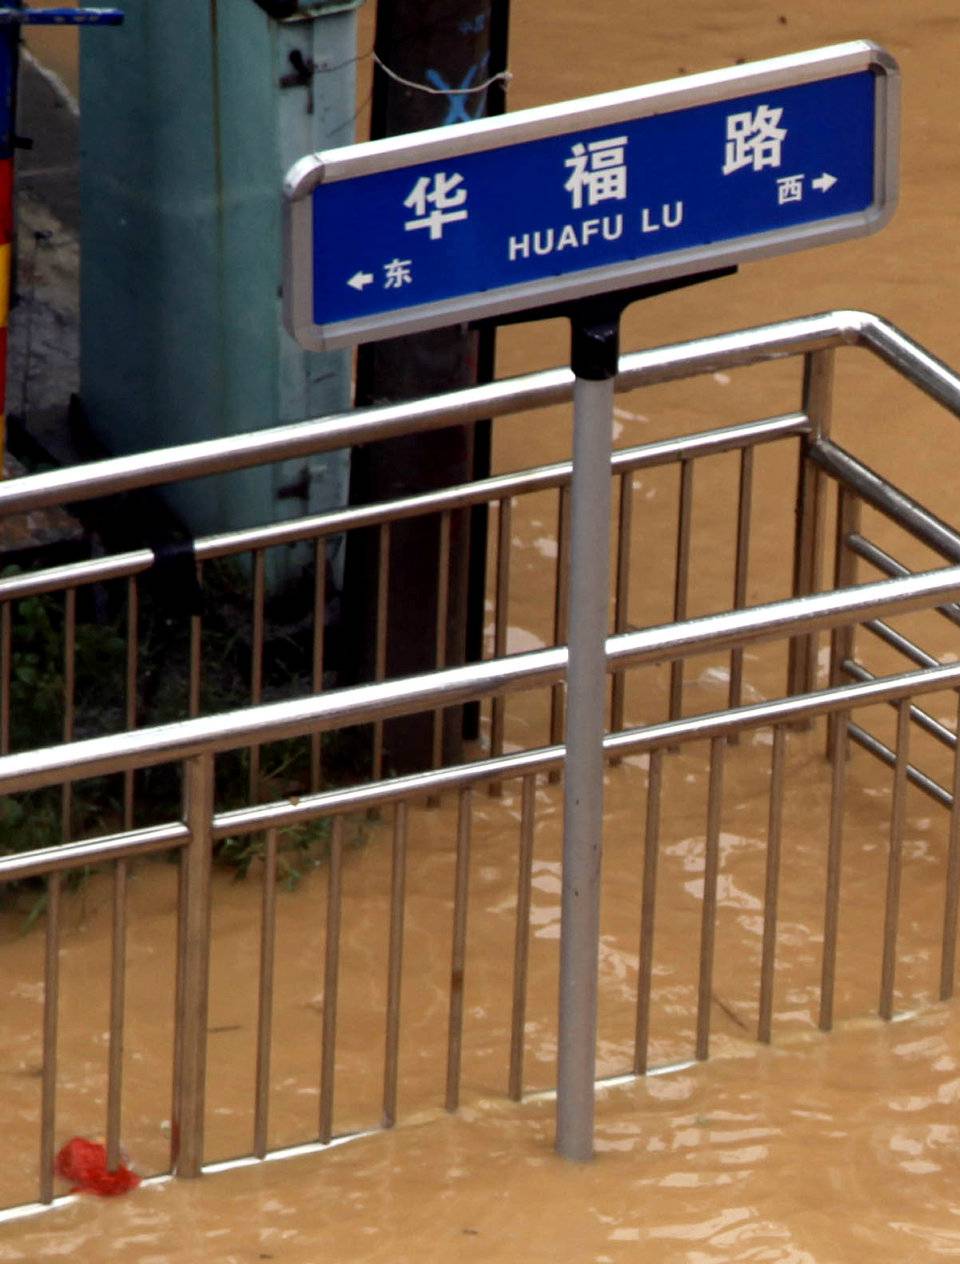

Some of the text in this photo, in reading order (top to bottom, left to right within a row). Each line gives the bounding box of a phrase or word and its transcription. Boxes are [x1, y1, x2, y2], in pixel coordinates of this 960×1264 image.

[404, 105, 787, 240] 华福路
[776, 174, 805, 205] 西
[509, 201, 683, 261] HUAFU LU
[384, 259, 412, 288] 东
